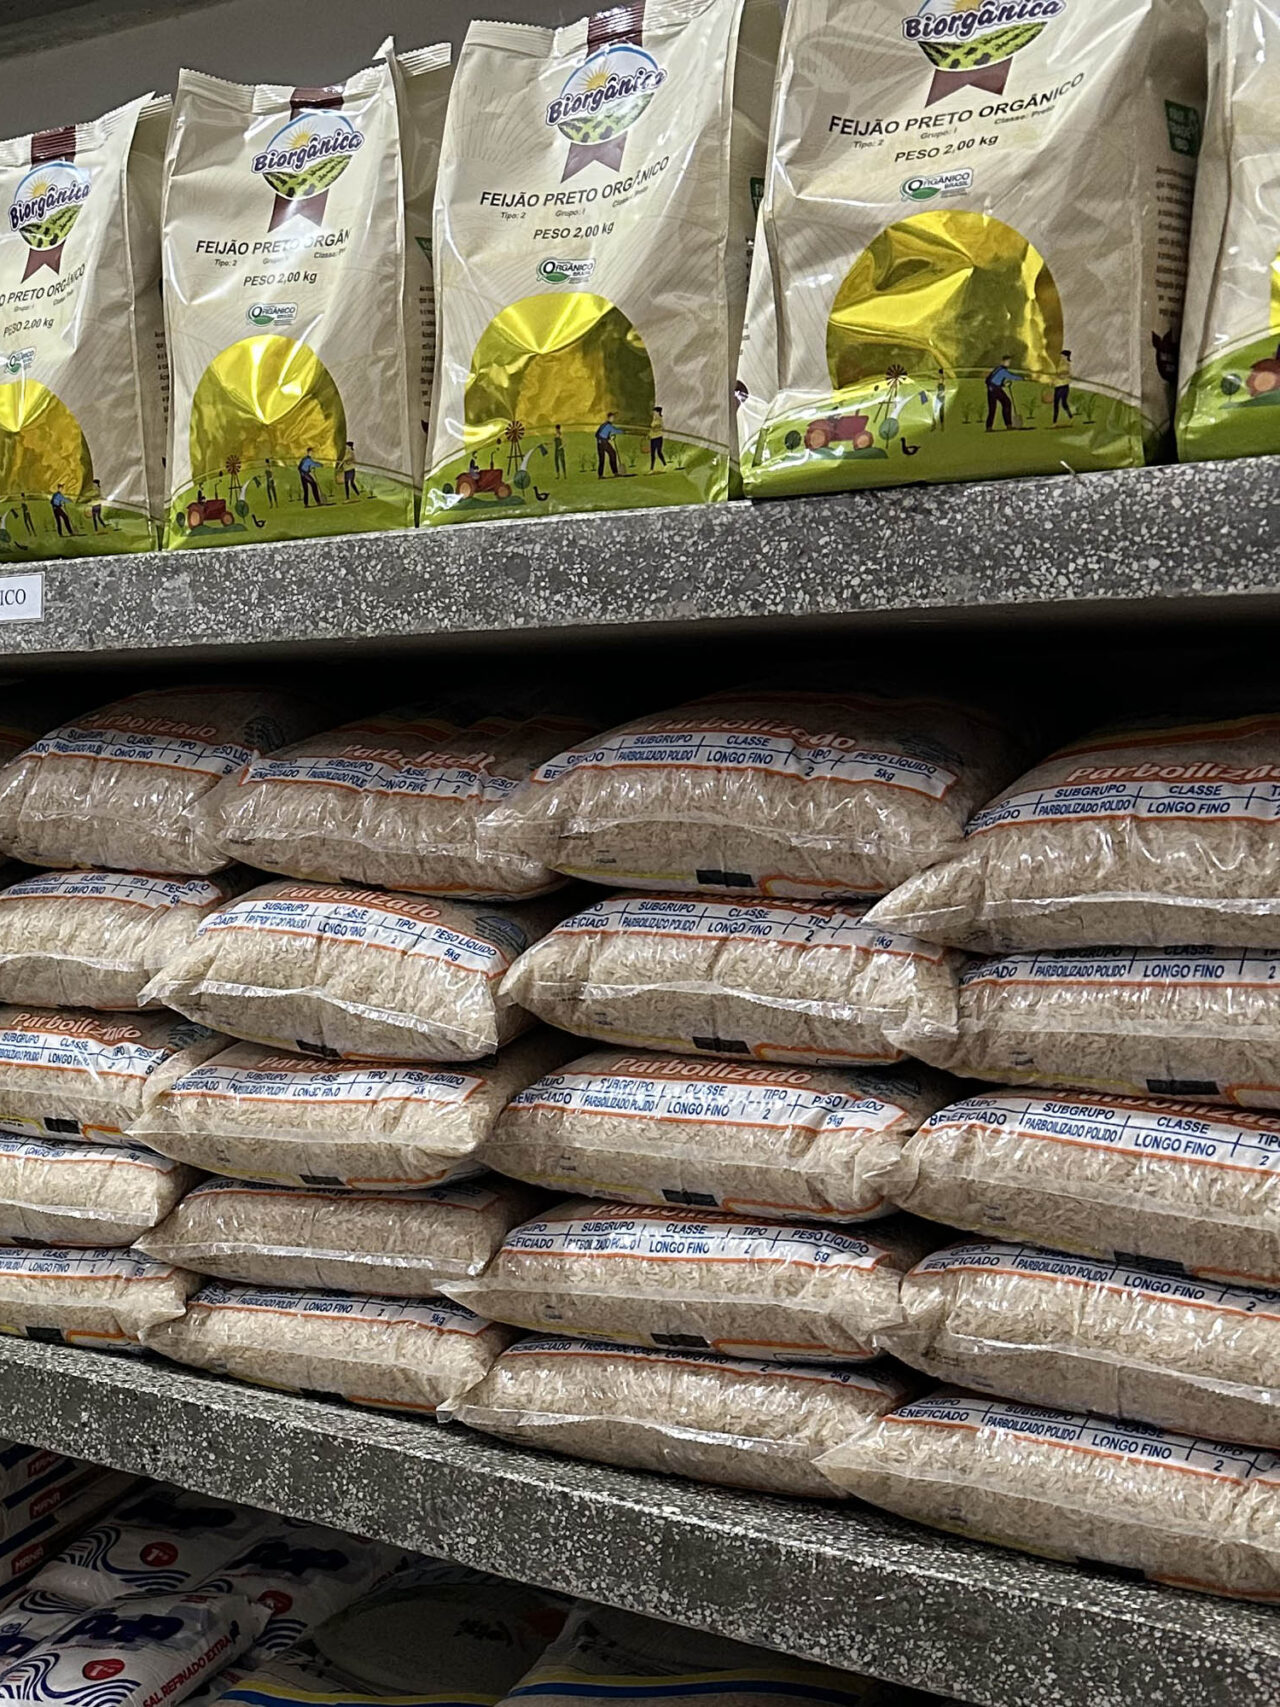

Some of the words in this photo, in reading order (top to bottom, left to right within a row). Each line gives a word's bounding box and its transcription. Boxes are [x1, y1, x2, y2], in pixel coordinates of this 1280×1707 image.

[829, 115, 899, 136] FEIJÃO
[905, 110, 973, 132] PRETO
[978, 73, 1085, 118] ORGÂNICO
[895, 147, 940, 163] PESO
[943, 138, 975, 156] 2,00
[979, 134, 999, 147] kg
[480, 191, 539, 208] FEIJÃO
[543, 187, 597, 206] PRETO
[533, 227, 571, 241] PESO
[573, 223, 599, 239] 2,00
[601, 221, 615, 235] kg
[196, 240, 249, 255] FEIJÃO
[244, 274, 275, 286] PESO
[278, 273, 300, 285] 2,00
[303, 271, 317, 283] kg
[8, 288, 43, 306] PRETO
[43, 316, 54, 328] kg
[634, 733, 693, 745] SUBGRUPO
[727, 735, 770, 747] CLASSE
[707, 751, 747, 764] LONGO
[749, 752, 774, 765] FINO
[804, 766, 814, 777] 2
[874, 768, 895, 781] 5kg
[1055, 784, 1126, 797] SUBGRUPO
[1169, 785, 1222, 796] CLASSE
[1039, 801, 1098, 815] PARBOILIZADO
[1099, 799, 1131, 813] POLIDO
[1148, 802, 1194, 813] LONGO
[1198, 802, 1230, 813] FINO
[638, 902, 696, 913] SUBGRUPO
[395, 918, 416, 929] TIPO
[708, 922, 745, 935] LONGO
[746, 923, 772, 936] FINO
[805, 929, 816, 942] 2
[1035, 965, 1092, 977] PARBOILIZADO
[1095, 965, 1126, 977] POLIDO
[1143, 964, 1192, 979] LONGO
[1194, 964, 1224, 979] FINO
[1268, 966, 1276, 979] 2
[611, 1056, 813, 1086] Parboilizado
[763, 1088, 788, 1100] TIPO
[667, 1102, 706, 1115] LONGO
[1043, 1102, 1115, 1121] SUBGRUPO
[1157, 1116, 1211, 1135] CLASSE
[1024, 1117, 1082, 1138] PARBOILIZADO
[1084, 1126, 1117, 1143] POLIDO
[1134, 1133, 1183, 1152] LONGO
[1184, 1140, 1216, 1158] FINO
[1259, 1155, 1269, 1167] 2
[581, 1221, 634, 1232] SUBGRUPO
[666, 1223, 708, 1235] CLASSE
[743, 1227, 768, 1236] TIPO
[791, 1229, 822, 1242] PESO
[649, 1241, 684, 1254] LONGO
[686, 1242, 710, 1255] FINO
[1018, 1258, 1075, 1278] PARBOILIZADO
[1076, 1264, 1108, 1282] POLIDO
[1124, 1274, 1170, 1294] LONGO
[1171, 1281, 1205, 1300] FINO
[1245, 1301, 1257, 1312] 2
[304, 1302, 331, 1313] LONGO
[987, 1415, 1043, 1438] PARBOILIZADO
[1044, 1423, 1076, 1441] POLIDO
[1092, 1434, 1138, 1455] LONGO
[1139, 1443, 1172, 1460] FINO
[1213, 1460, 1225, 1472] 2
[142, 1691, 161, 1707] SAL
[161, 1660, 205, 1699] REFINADO
[206, 1636, 231, 1665] EXTRA
